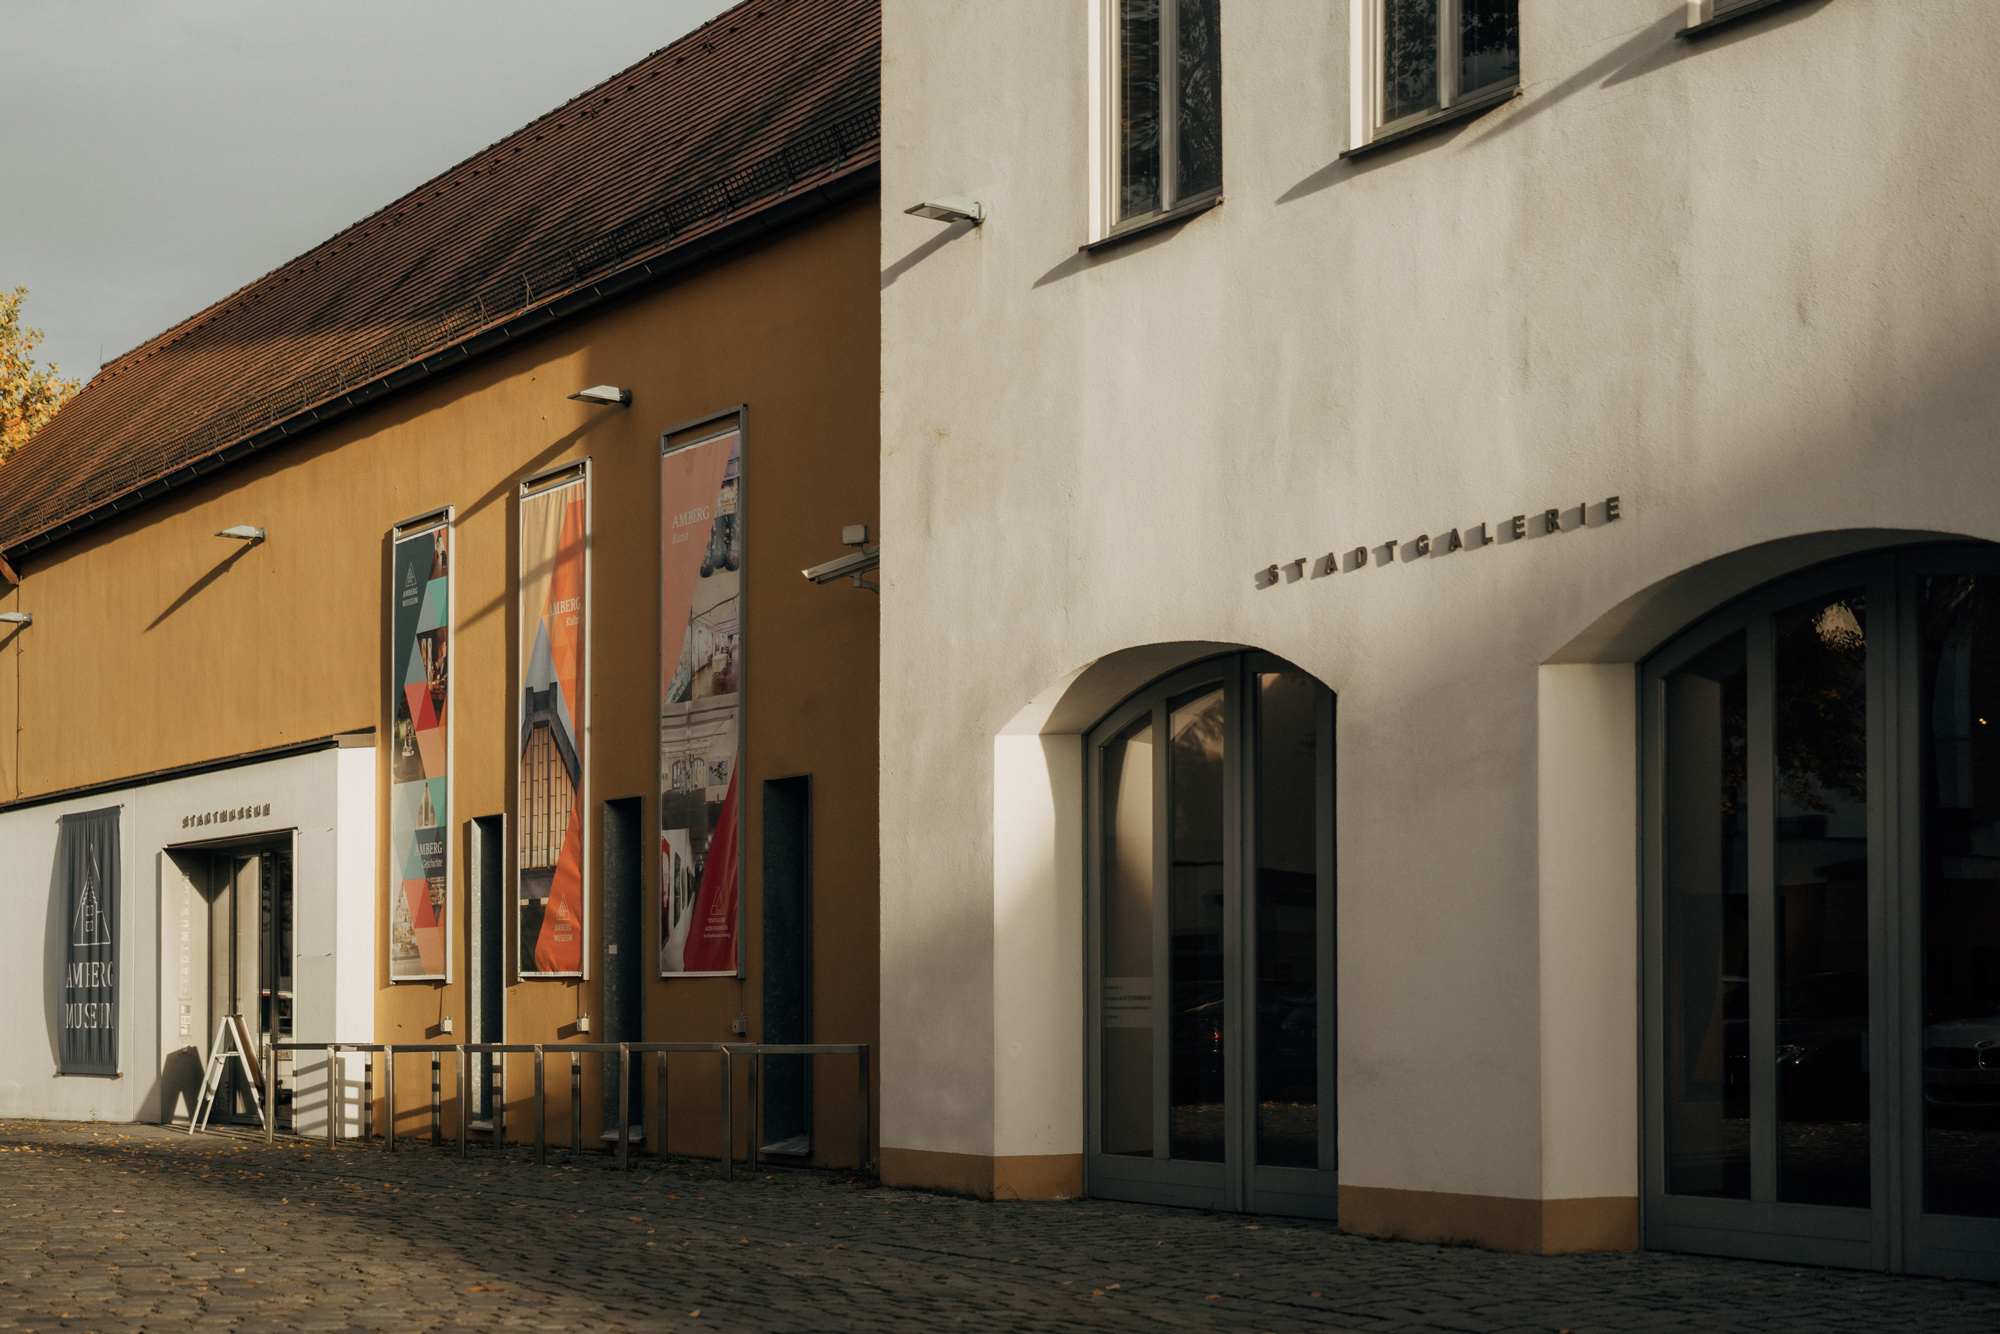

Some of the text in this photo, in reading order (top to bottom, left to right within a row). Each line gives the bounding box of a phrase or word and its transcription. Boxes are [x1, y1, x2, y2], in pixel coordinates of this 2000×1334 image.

[672, 505, 710, 529] AMBERG
[672, 531, 689, 544] Kunst
[1267, 495, 1620, 586] STADTGALERIE
[549, 597, 580, 616] AMBERG
[182, 803, 271, 829] STADTMUSEUM
[414, 841, 443, 856] AMBERG
[65, 961, 114, 988] AMBERG
[65, 1002, 114, 1029] MUSEUM
